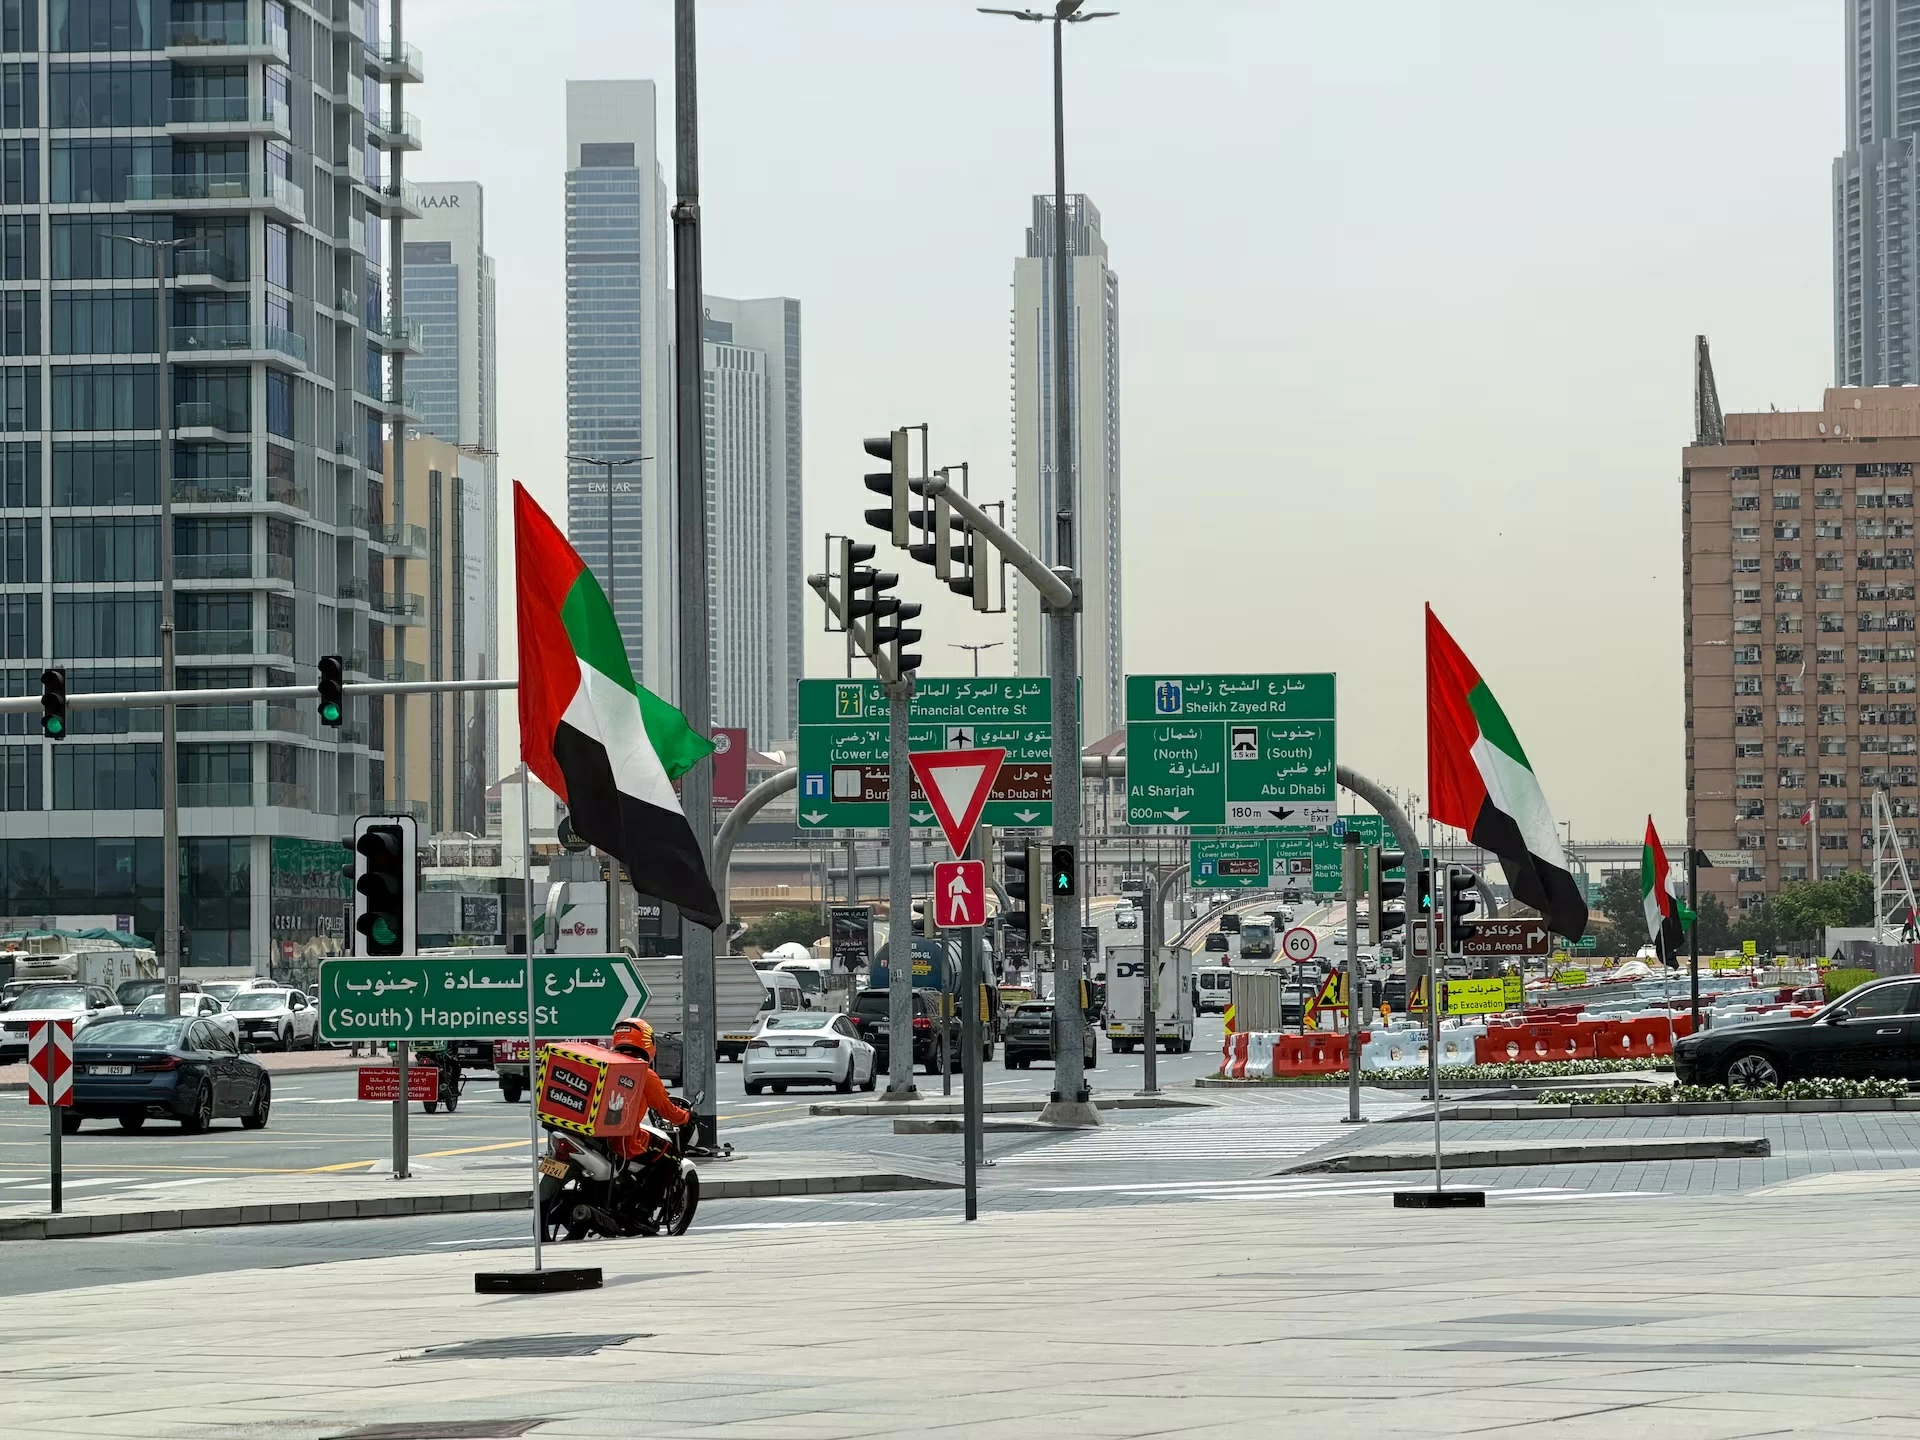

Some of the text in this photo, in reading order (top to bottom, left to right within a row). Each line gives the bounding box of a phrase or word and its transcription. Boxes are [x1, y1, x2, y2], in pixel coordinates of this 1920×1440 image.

[416, 194, 460, 208] MAAR
[910, 683, 950, 704] المالي
[955, 683, 998, 699] المركز
[1004, 683, 1041, 699] شارع
[1185, 679, 1305, 696] شارع الشيخ زايد
[840, 699, 859, 714] 71
[1161, 695, 1176, 710] 11
[1186, 701, 1286, 714] Sheikh Zayed Rd
[864, 704, 1028, 717] (Eas Financial Centre St
[1153, 727, 1203, 742] (شمال)
[1266, 726, 1321, 740] (جنوب)
[830, 749, 871, 761] (Lower
[1153, 748, 1198, 761] (North)
[1266, 746, 1313, 760] (South)
[1168, 761, 1220, 778] الشارقة
[1276, 759, 1331, 781] أبو ظبي
[1007, 788, 1039, 799] Dubai
[1130, 785, 1195, 798] Al Sharjah
[1260, 783, 1326, 795] Abu Dhabi
[1310, 815, 1329, 823] EXIT
[1290, 938, 1310, 950] 60
[1495, 942, 1523, 951] Arena
[334, 968, 606, 999] شارع لسعادة (جنوب)
[1468, 985, 1502, 995] حفريات
[1460, 1000, 1503, 1009] Excavation
[328, 1005, 559, 1032] (South) Happiness St
[555, 1070, 588, 1092] طلبات
[549, 1089, 584, 1111] talabat
